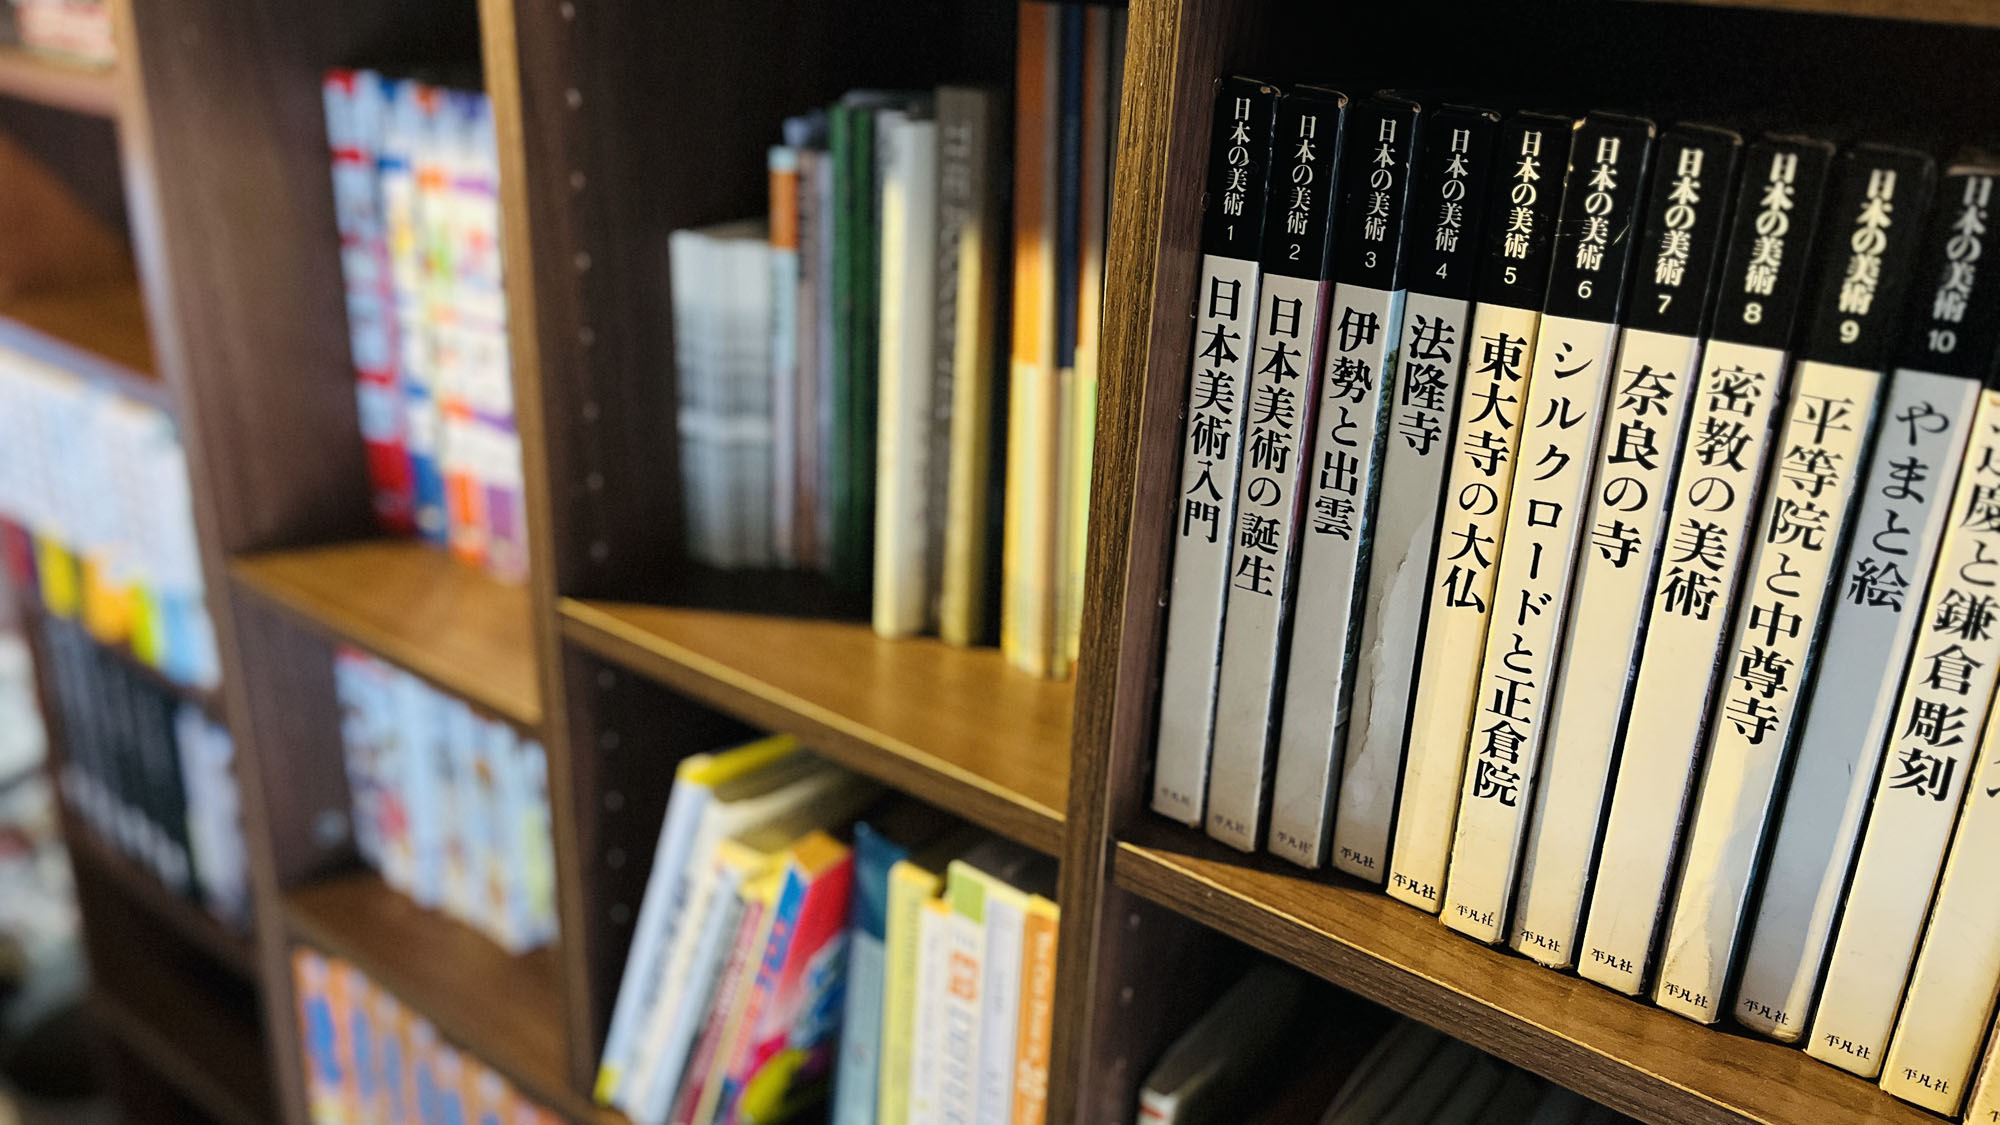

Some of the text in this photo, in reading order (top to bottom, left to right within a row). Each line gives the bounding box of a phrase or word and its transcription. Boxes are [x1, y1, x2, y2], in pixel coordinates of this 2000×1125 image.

[1223, 97, 1251, 241] 日本の美術 1
[1287, 115, 1317, 261] 日本の美術 2
[1364, 118, 1398, 269] 日本の美術 3
[1435, 129, 1471, 280] 日本の美術 4
[1503, 131, 1542, 285] 日本の美術 5
[1576, 137, 1620, 299] 日本の美術 6
[1655, 149, 1704, 314] 日本の美術 7
[1743, 153, 1798, 325] 日本の美術 8
[1838, 169, 1896, 343] 日本の美術 9
[1928, 176, 1992, 353] 日本の美術 10
[1182, 276, 1242, 543] 日本美術入門
[1234, 294, 1303, 597] 日本美術の誕生
[1313, 306, 1380, 541] 伊勢と出雲
[1398, 315, 1455, 456] 法隆寺
[1441, 333, 1528, 614] 東大寺の大仏
[1591, 364, 1677, 568] 奈良の寺
[1659, 364, 1766, 621] 密教の美術
[1847, 400, 1949, 613] やまと絵
[1472, 342, 1593, 807] シルクロードと正倉院
[1725, 393, 1855, 745] 平等院と中尊寺
[1340, 845, 1376, 870] 平凡社
[1393, 872, 1437, 902] 平凡社
[1456, 903, 1494, 928] 平凡社
[1520, 929, 1561, 954] 平凡社
[1590, 948, 1634, 975] 平凡社
[1664, 981, 1709, 1010] 平凡社
[1743, 998, 1790, 1026] 平凡社
[1824, 1032, 1871, 1061] 平凡社
[1902, 1067, 1950, 1096] 平凡社
